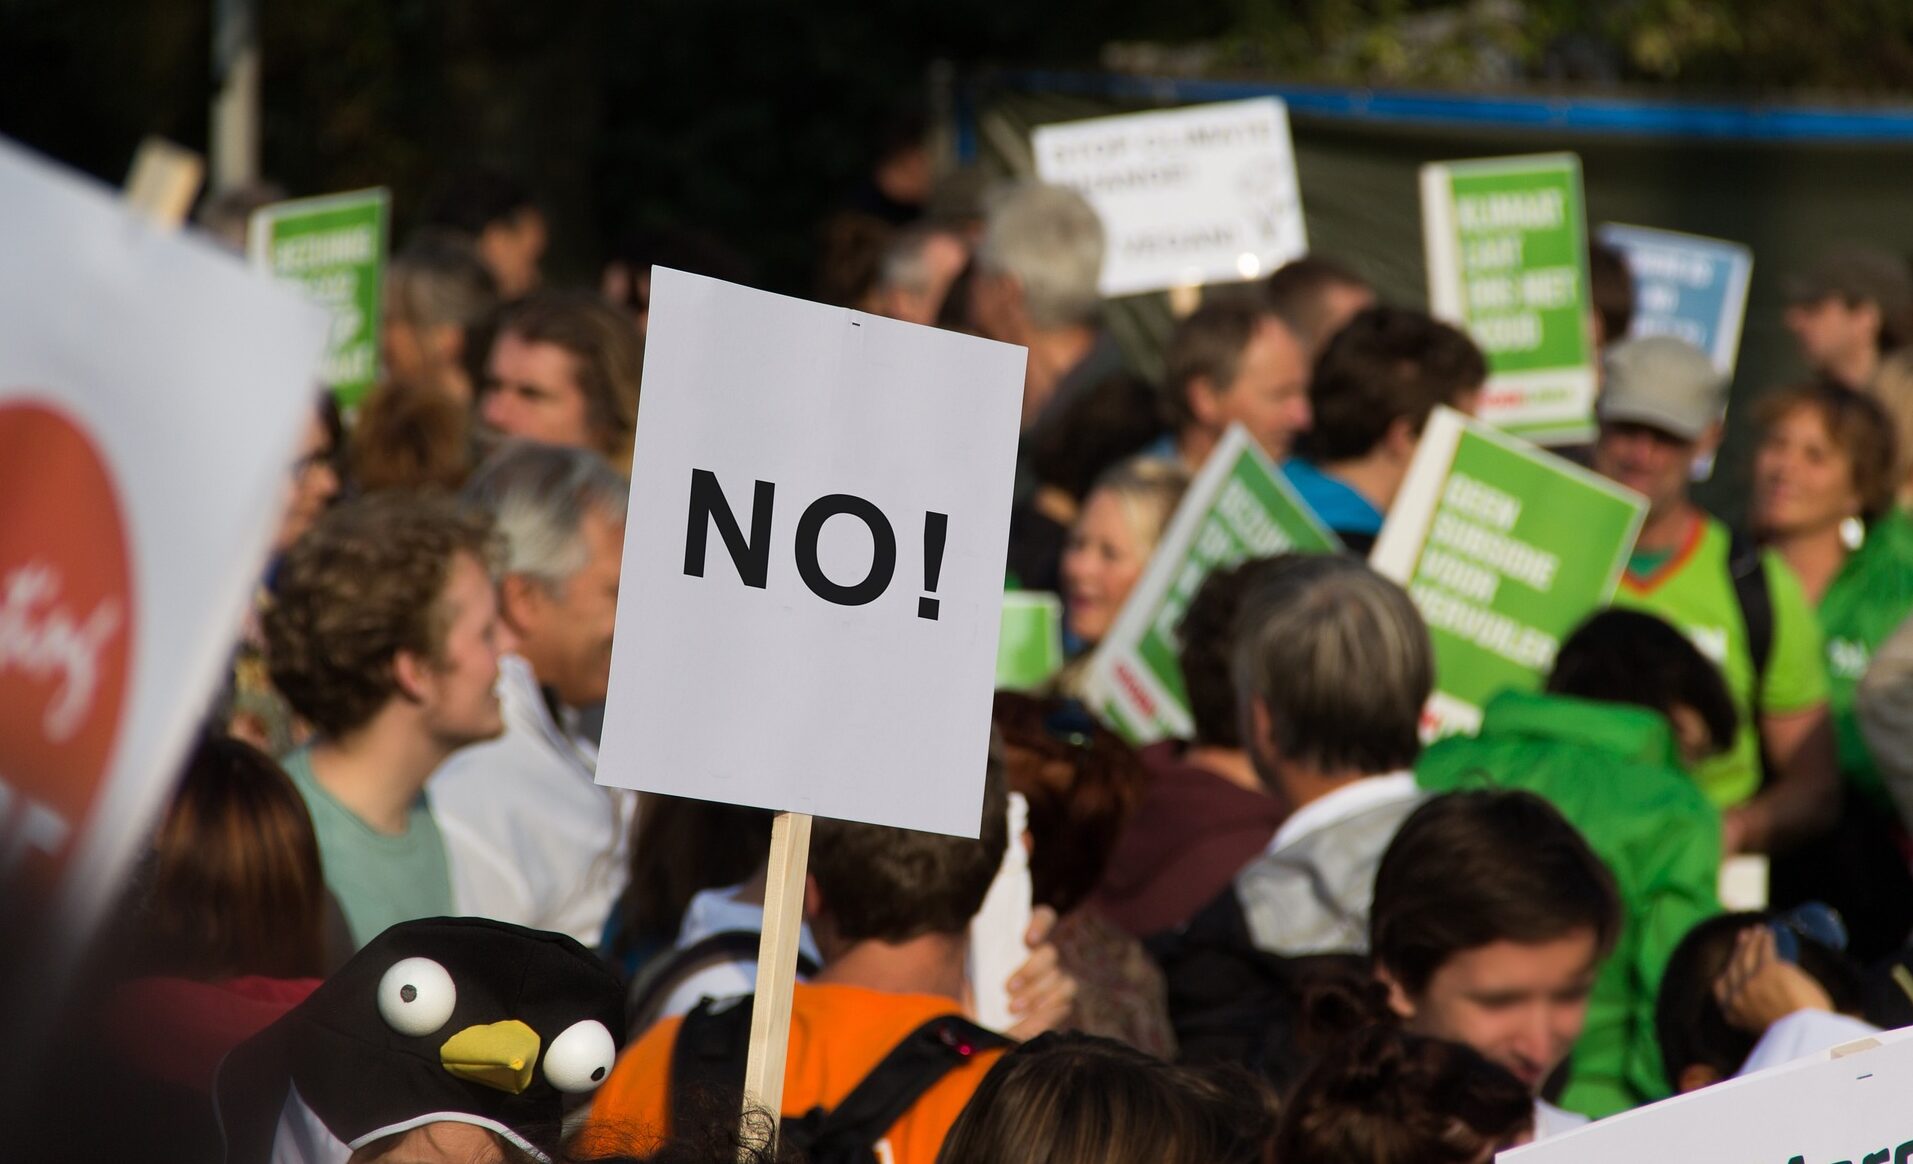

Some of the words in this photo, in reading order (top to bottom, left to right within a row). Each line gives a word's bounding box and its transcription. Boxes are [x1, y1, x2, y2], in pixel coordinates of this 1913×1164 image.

[1445, 472, 1522, 533] GEEN
[683, 468, 948, 621] NO!
[1418, 545, 1499, 604] VOOR
[1431, 507, 1560, 594] SUBSIDIE
